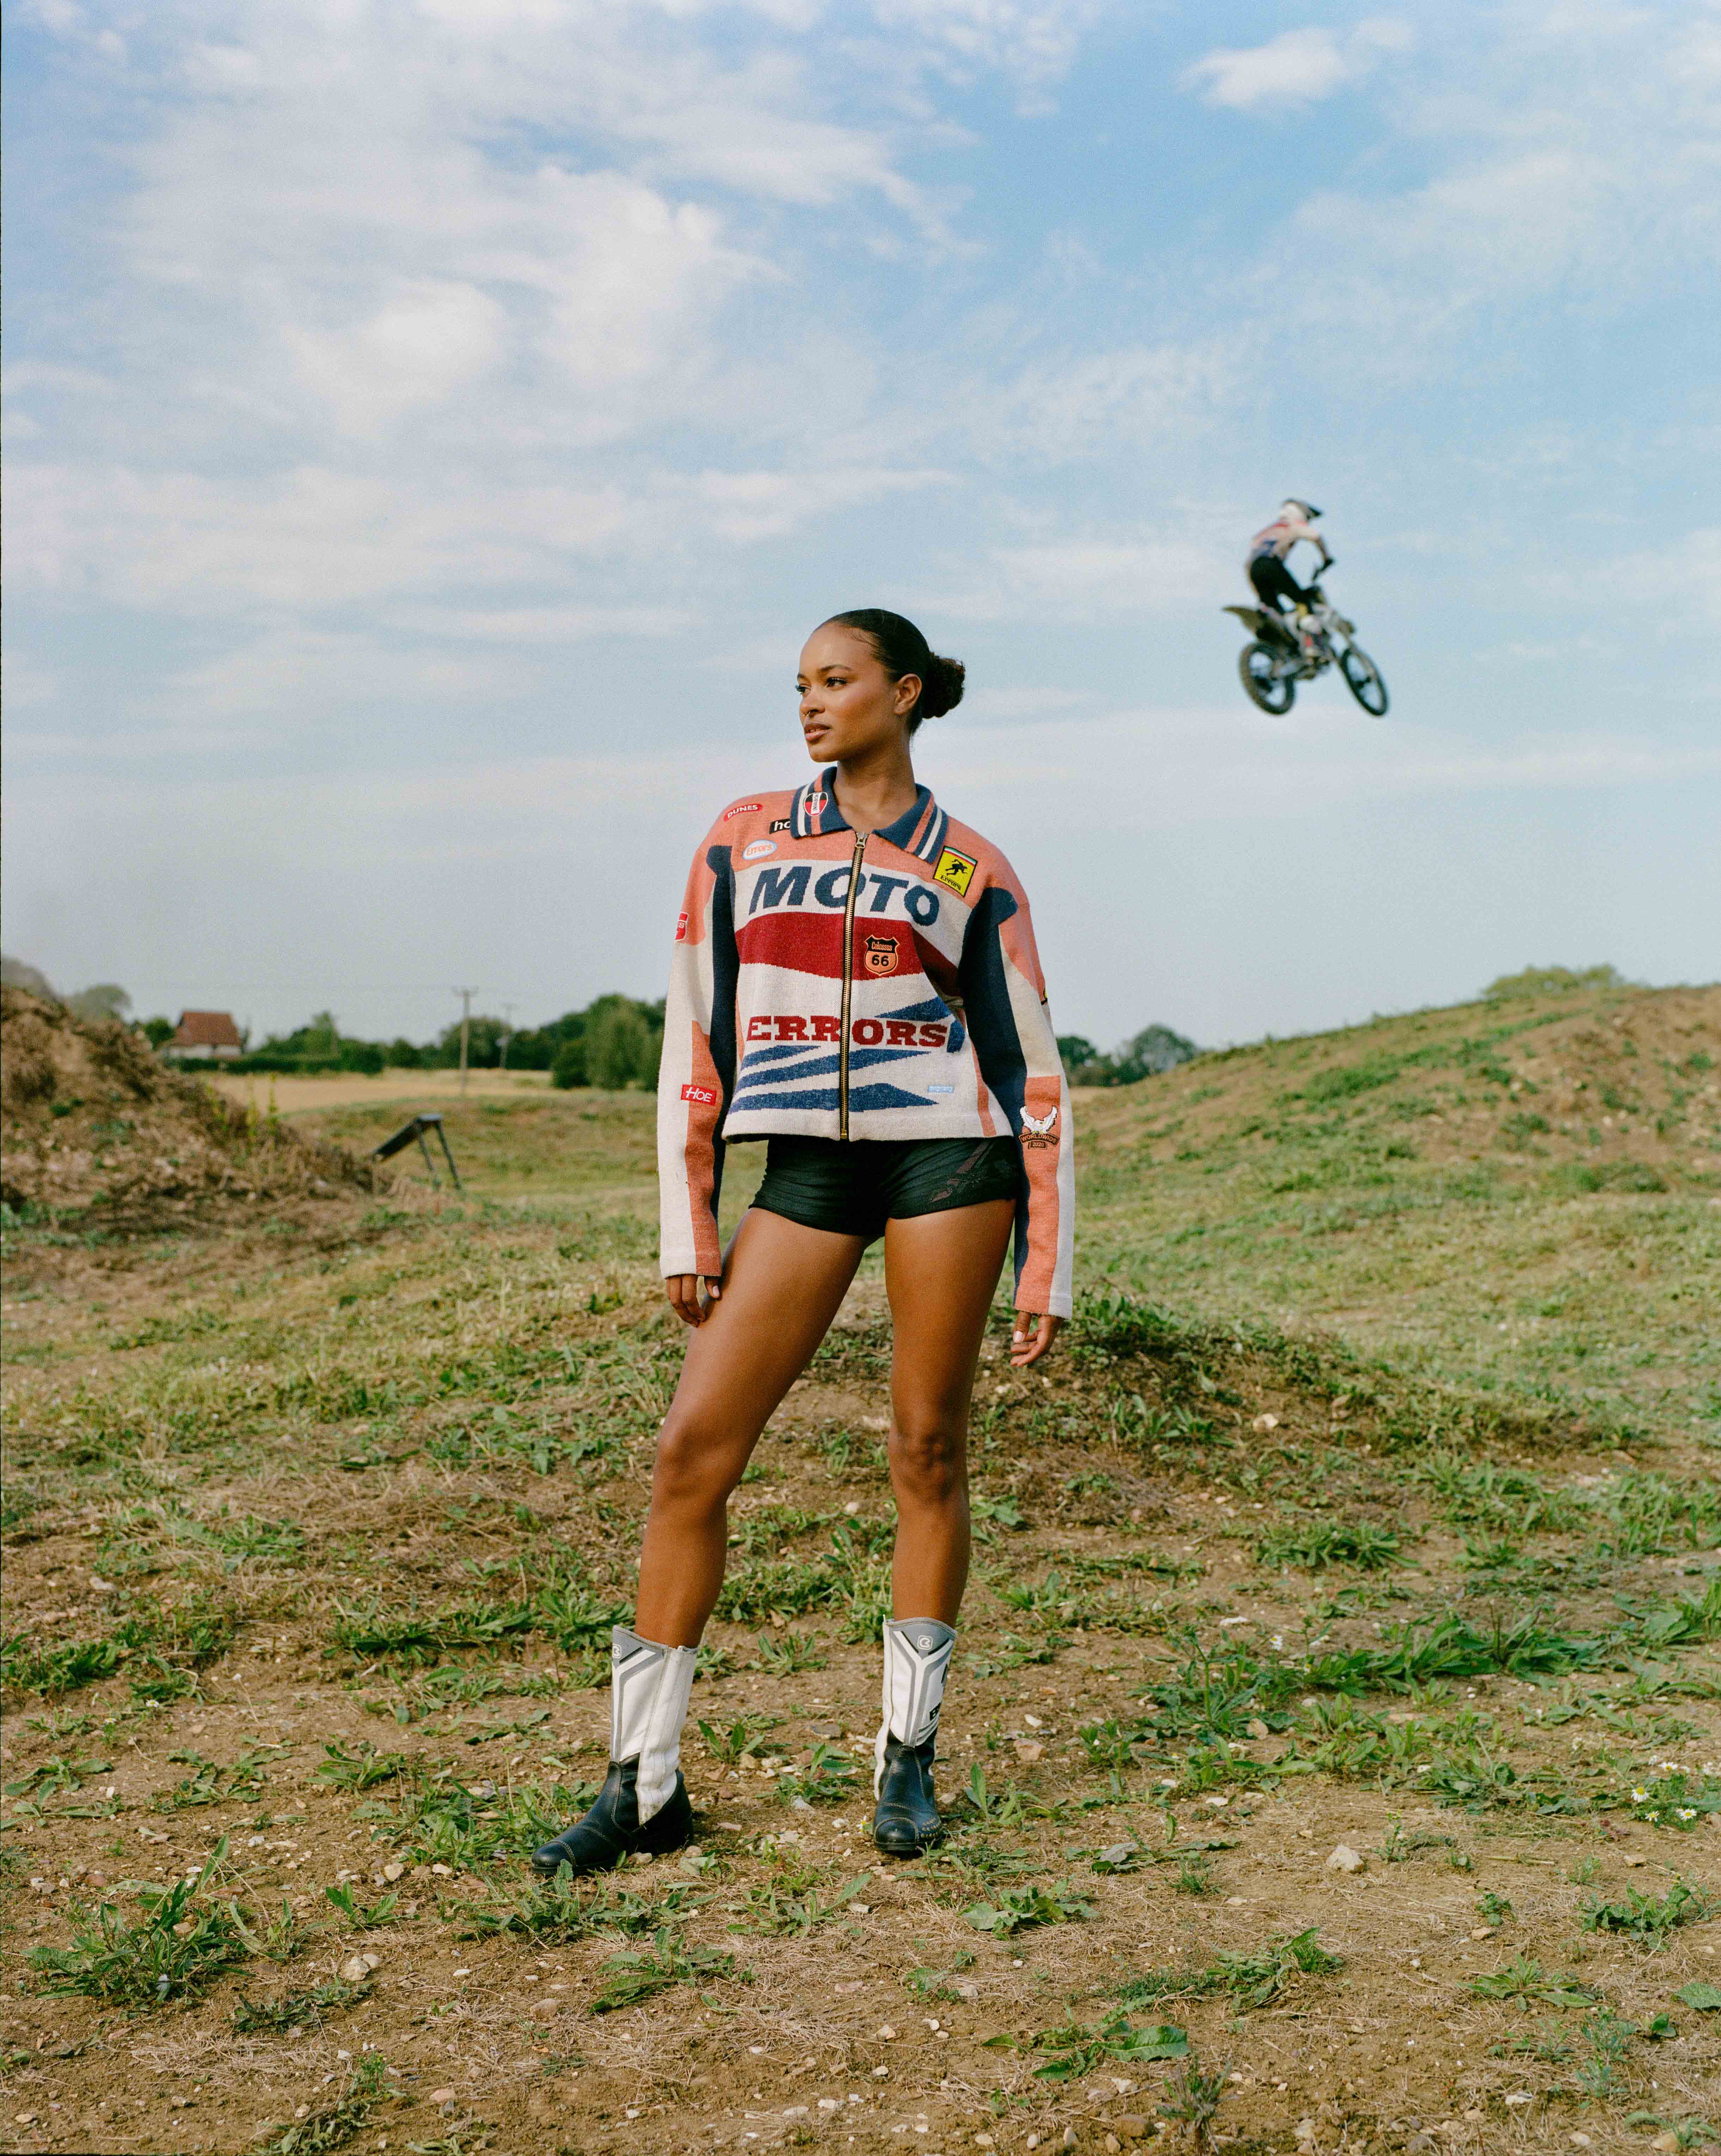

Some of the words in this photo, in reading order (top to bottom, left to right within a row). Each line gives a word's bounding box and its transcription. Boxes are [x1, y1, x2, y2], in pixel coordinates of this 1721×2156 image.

[774, 821, 790, 831] ho
[749, 866, 939, 927] MOTO
[871, 941, 892, 951] Colossus
[872, 954, 889, 966] 66
[747, 1015, 947, 1048] ERRORS
[1021, 1134, 1057, 1143] WORLDWIDE
